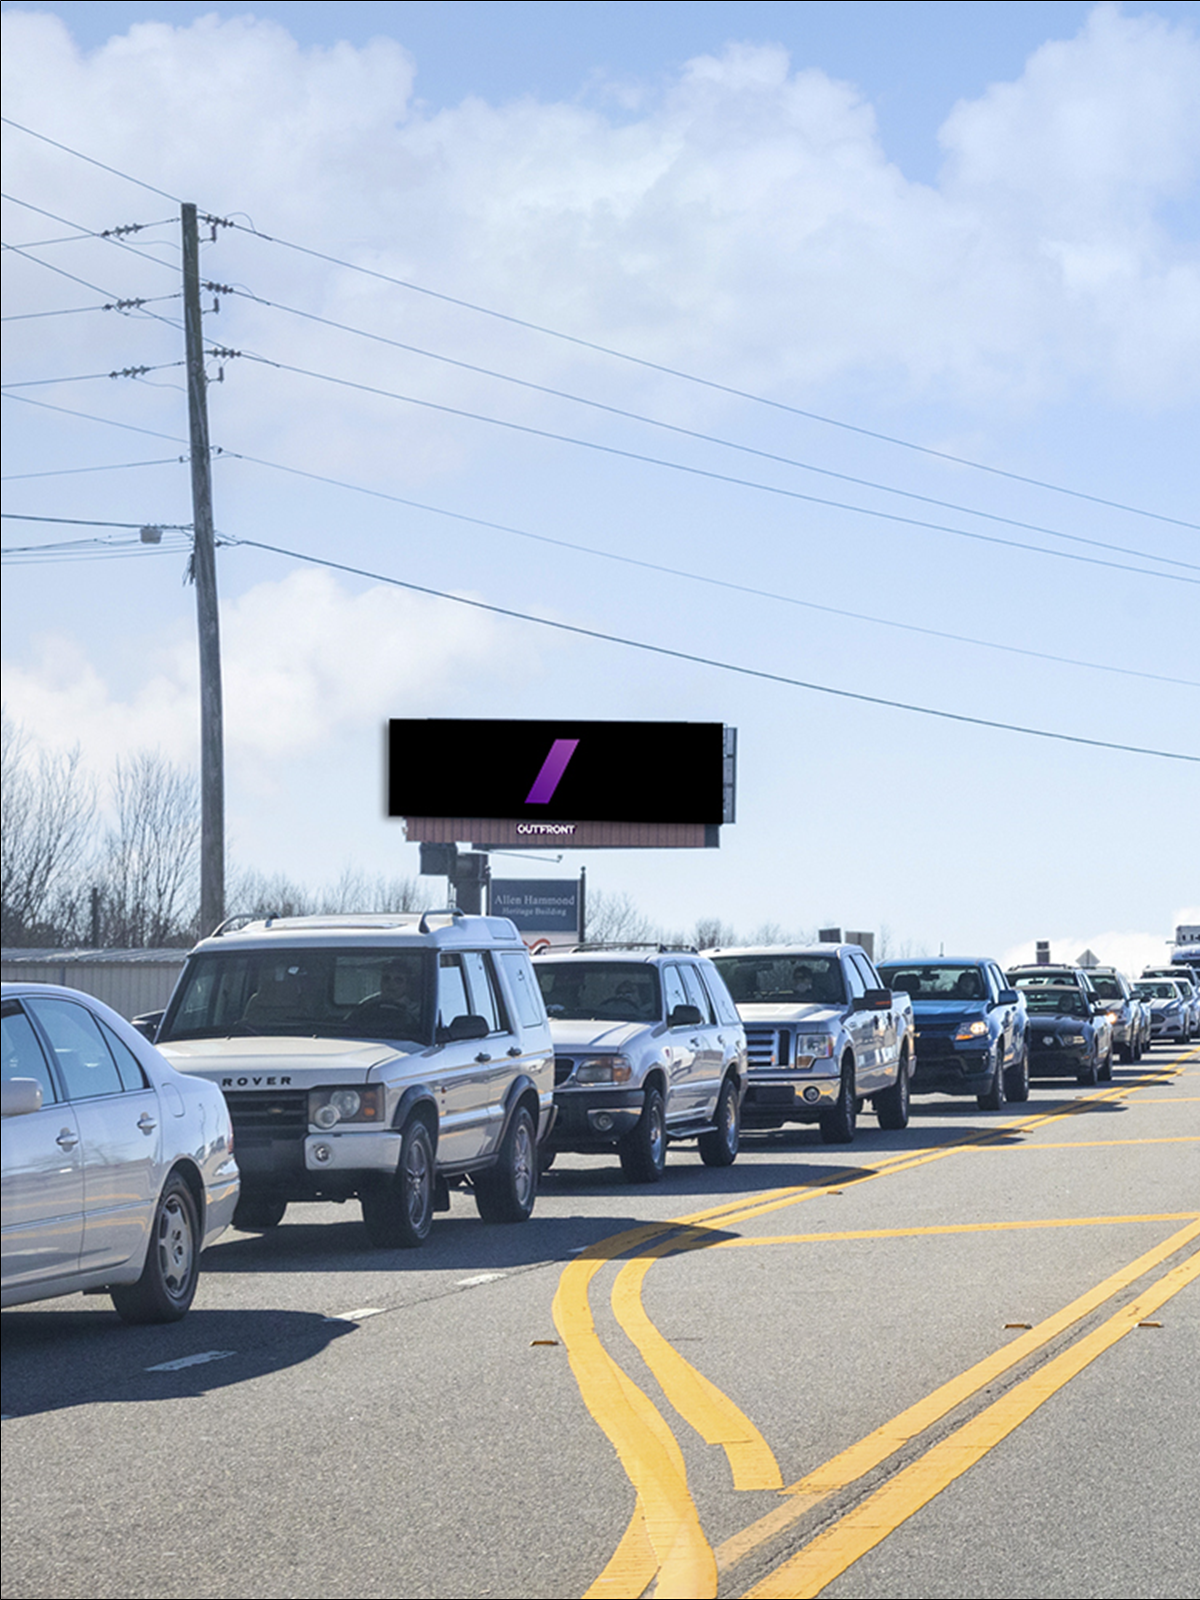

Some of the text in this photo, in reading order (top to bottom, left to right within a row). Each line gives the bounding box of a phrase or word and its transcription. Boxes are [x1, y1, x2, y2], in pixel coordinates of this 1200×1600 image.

[517, 824, 575, 834] OUTFRONT
[494, 895, 575, 905] Allen Hammond
[502, 907, 567, 917] Heritage Building
[222, 1076, 292, 1087] ROVER
